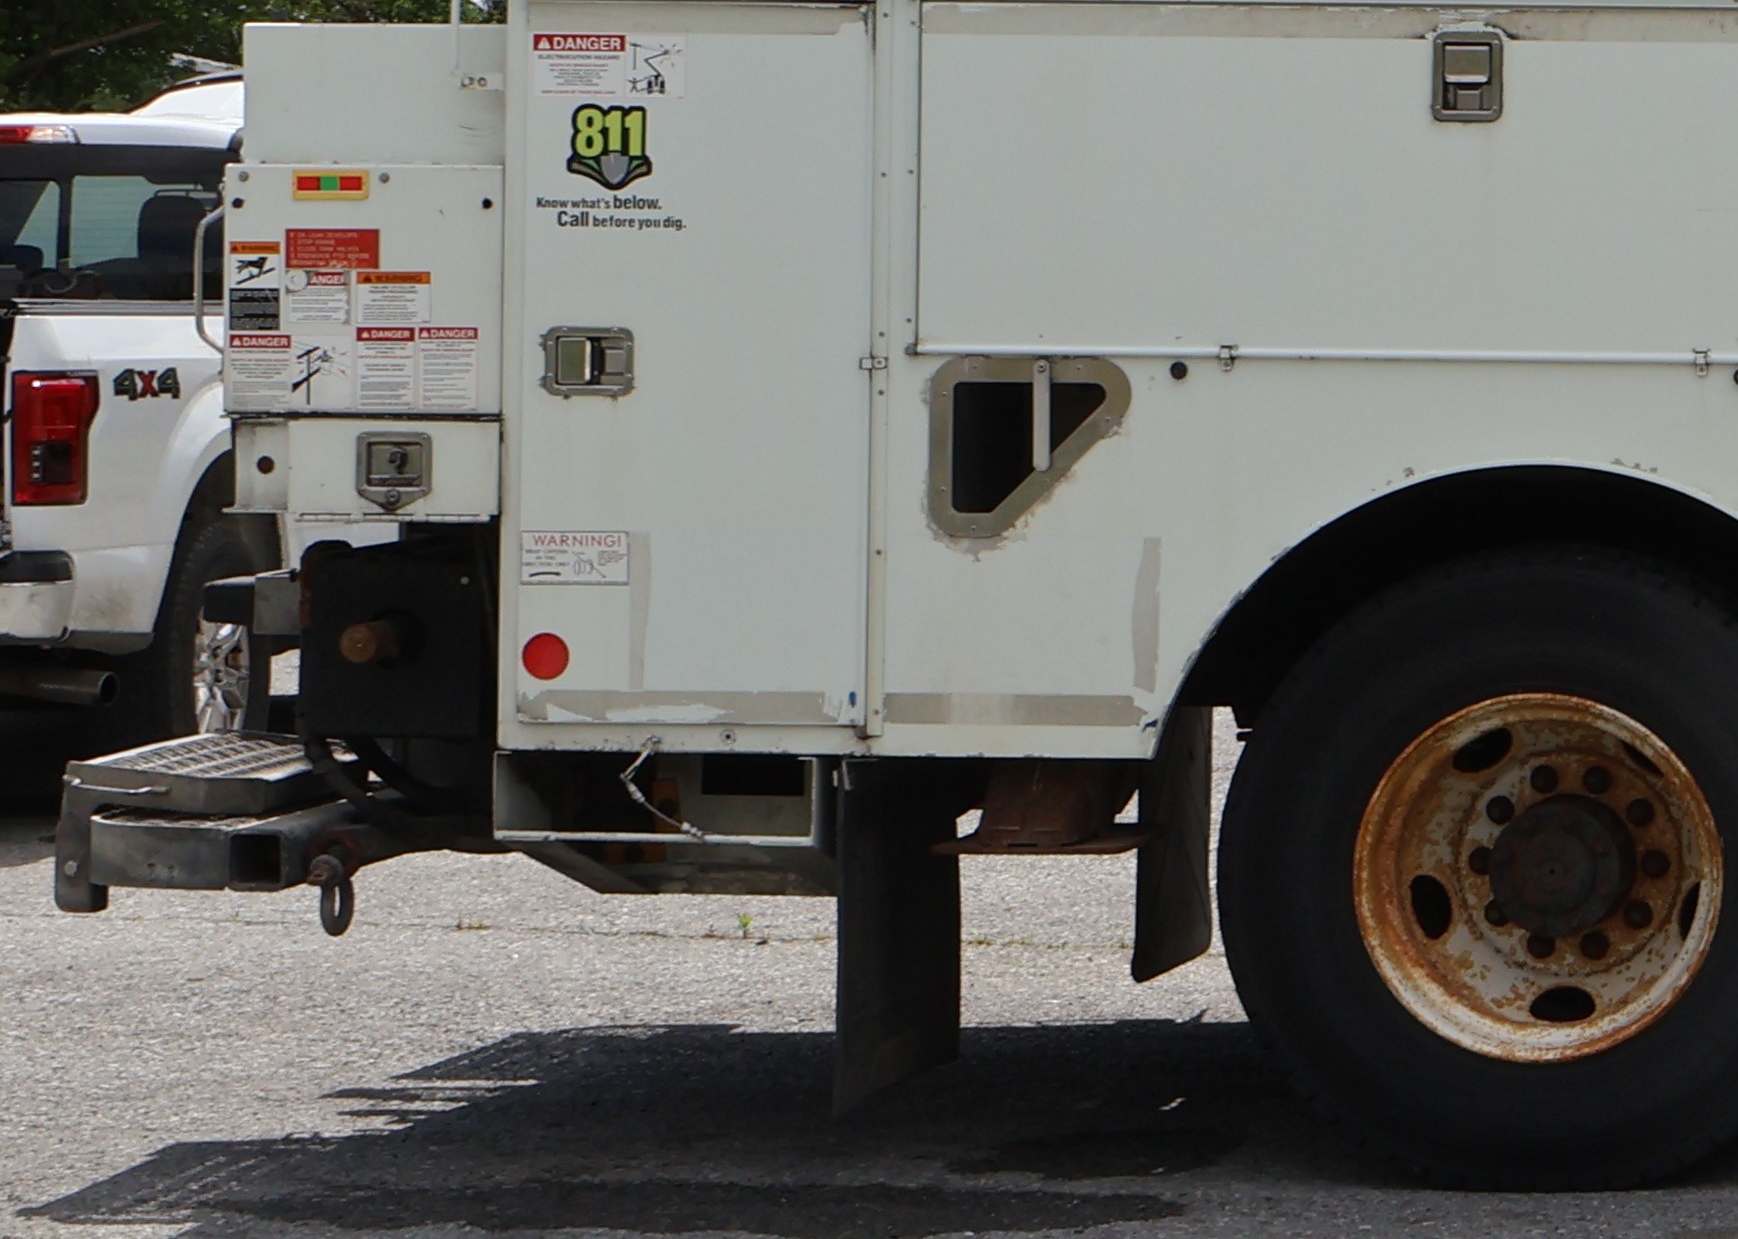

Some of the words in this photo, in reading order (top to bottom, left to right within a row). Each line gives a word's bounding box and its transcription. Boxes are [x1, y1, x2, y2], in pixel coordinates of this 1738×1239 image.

[553, 37, 621, 51] DANGER
[574, 106, 645, 158] 811
[536, 197, 569, 208] Know
[571, 198, 611, 209] what's
[613, 195, 662, 210] below.
[557, 211, 589, 227] Call
[592, 216, 635, 228] before
[638, 218, 661, 230] you
[663, 216, 687, 231] dig.
[371, 330, 411, 338] DANGER
[431, 330, 475, 338] DANGER
[243, 337, 289, 347] DANGER
